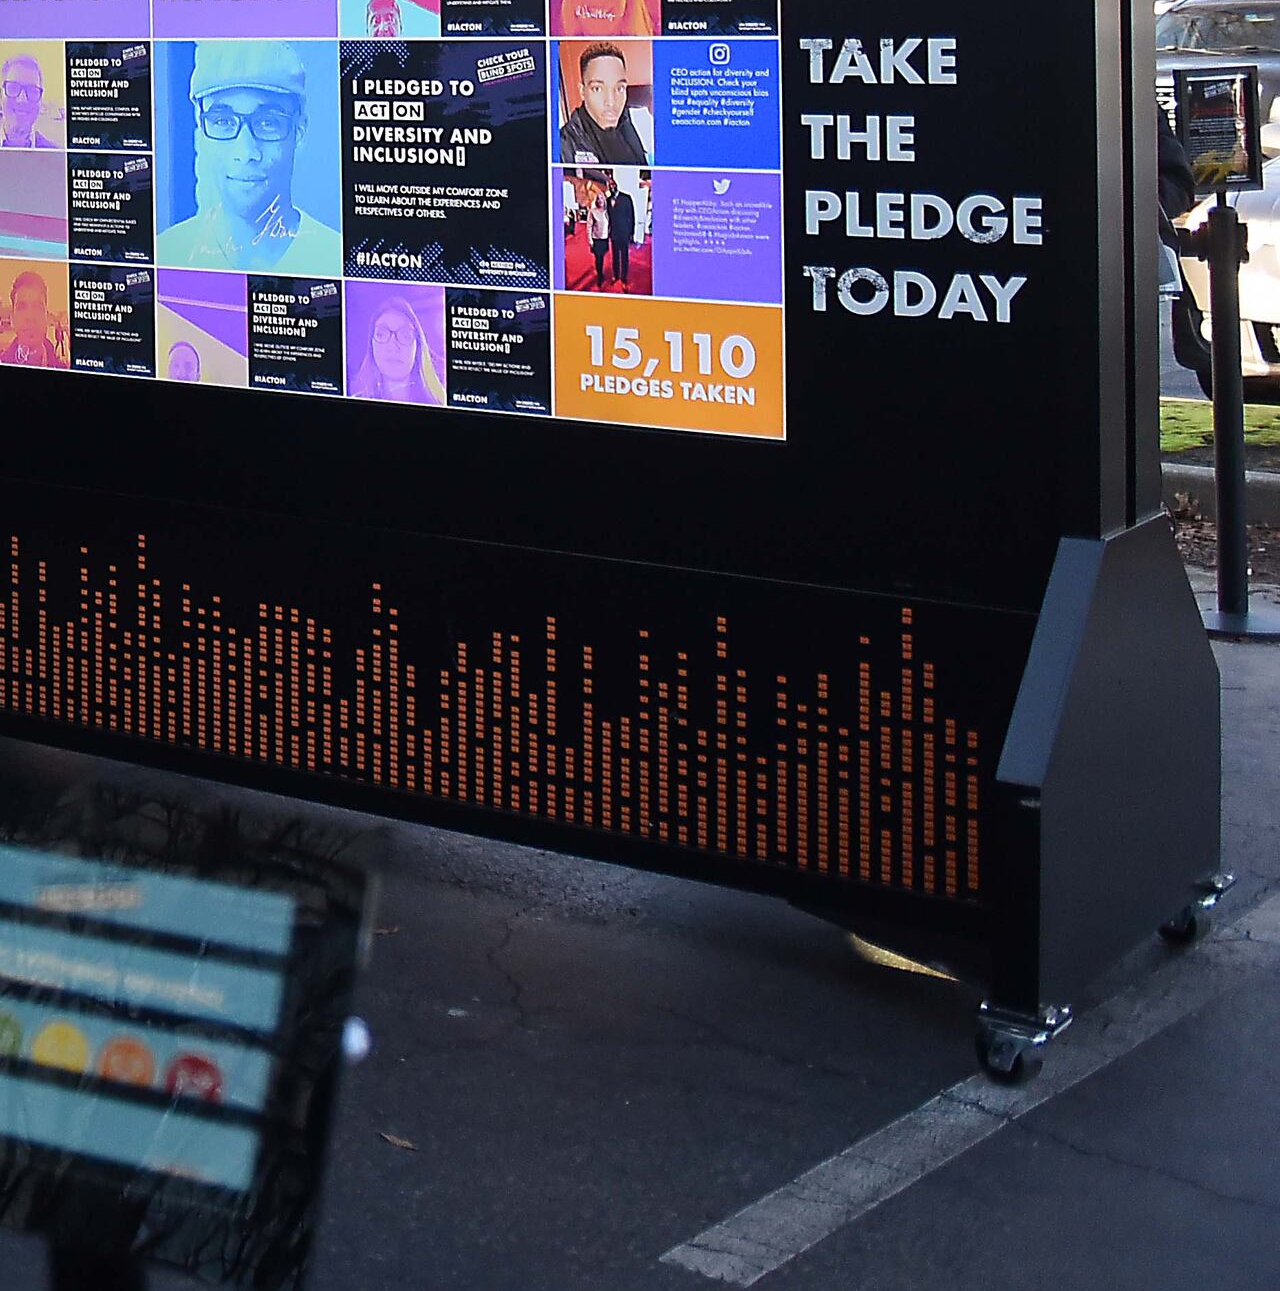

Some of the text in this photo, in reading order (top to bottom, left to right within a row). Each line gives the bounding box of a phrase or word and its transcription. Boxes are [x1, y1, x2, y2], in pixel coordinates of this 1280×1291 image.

[477, 48, 530, 68] CHECK YOUR
[800, 38, 958, 85] TAKE
[480, 67, 505, 79] BLIND
[506, 60, 532, 73] SPOTS
[671, 68, 770, 78] CEO action for diversity and
[352, 80, 475, 96] I PLEDGED TO
[671, 87, 769, 97] blind spots unconscious bias
[717, 78, 740, 86] Check
[741, 80, 758, 88] your
[356, 102, 423, 120] ACT ON
[353, 126, 492, 144] DIVERSITY AND
[801, 114, 915, 162] THE
[359, 184, 375, 193] WILL
[376, 185, 399, 193] MOVE
[400, 186, 431, 195] OUTSIDE
[432, 187, 445, 195] MY
[446, 187, 484, 197] COMFORT
[485, 188, 509, 198] ZONE
[355, 195, 501, 209] TO LEARN ABOUT THE EXPERIENCES AND
[355, 206, 402, 217] PERSPECTIVES
[403, 208, 414, 217] OF
[804, 190, 1044, 246] PLEDGE
[356, 252, 422, 269] #IACTON
[802, 265, 1028, 323] TODAY
[451, 330, 524, 344] DIVERSITY AND
[585, 325, 757, 379] 15,110
[580, 373, 755, 406] PLEDGES TAKEN
